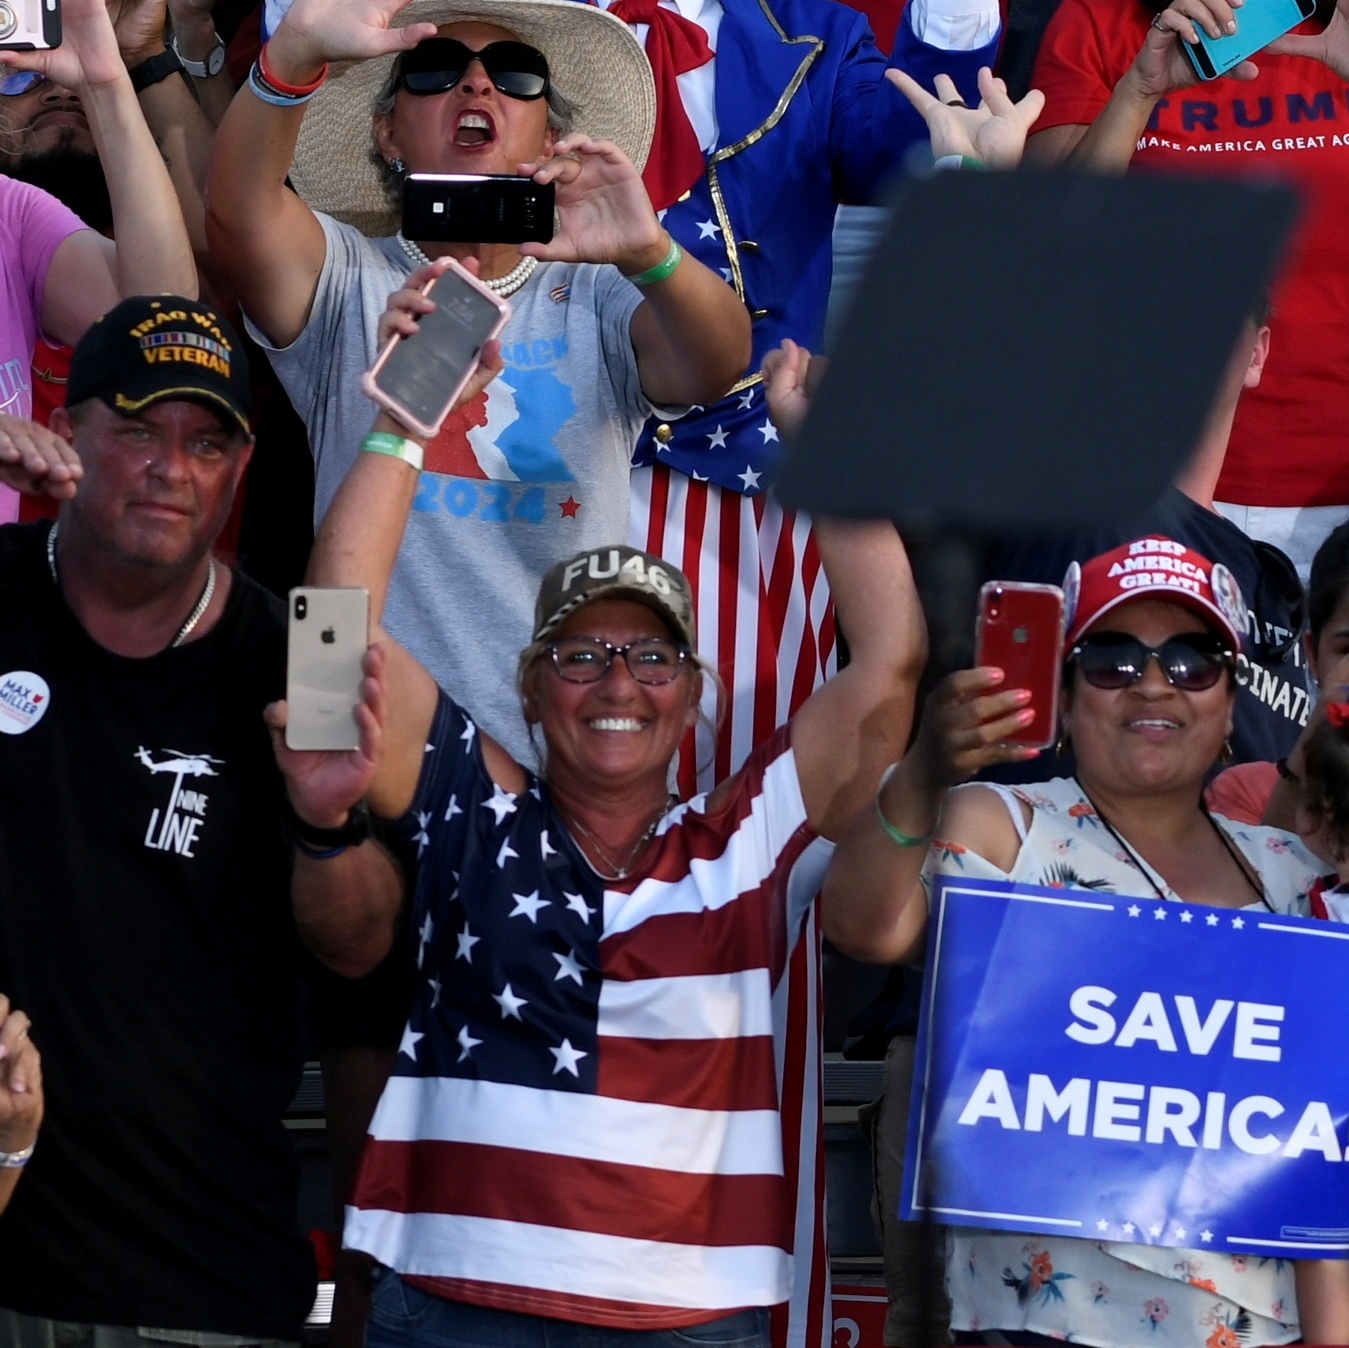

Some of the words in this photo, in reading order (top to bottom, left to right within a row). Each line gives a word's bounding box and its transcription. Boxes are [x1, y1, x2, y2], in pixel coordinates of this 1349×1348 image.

[1136, 137, 1182, 151] MAKE
[1186, 139, 1264, 152] AMERICA
[1271, 134, 1326, 151] GREAT
[130, 309, 187, 338] IRAQ
[190, 311, 232, 352] WAR
[143, 345, 231, 379] VETERAN
[412, 474, 547, 525] 2024
[1128, 538, 1186, 557] KEEP
[560, 549, 671, 596] FU46
[1107, 555, 1209, 585] AMERICA
[1119, 572, 1200, 594] GREAT!
[0, 691, 39, 716] MILLER
[5, 679, 30, 698] MAX
[1232, 651, 1312, 728] CINATE
[175, 787, 210, 817] NINE
[144, 802, 204, 859] LINE
[1064, 984, 1287, 1062] SAVE
